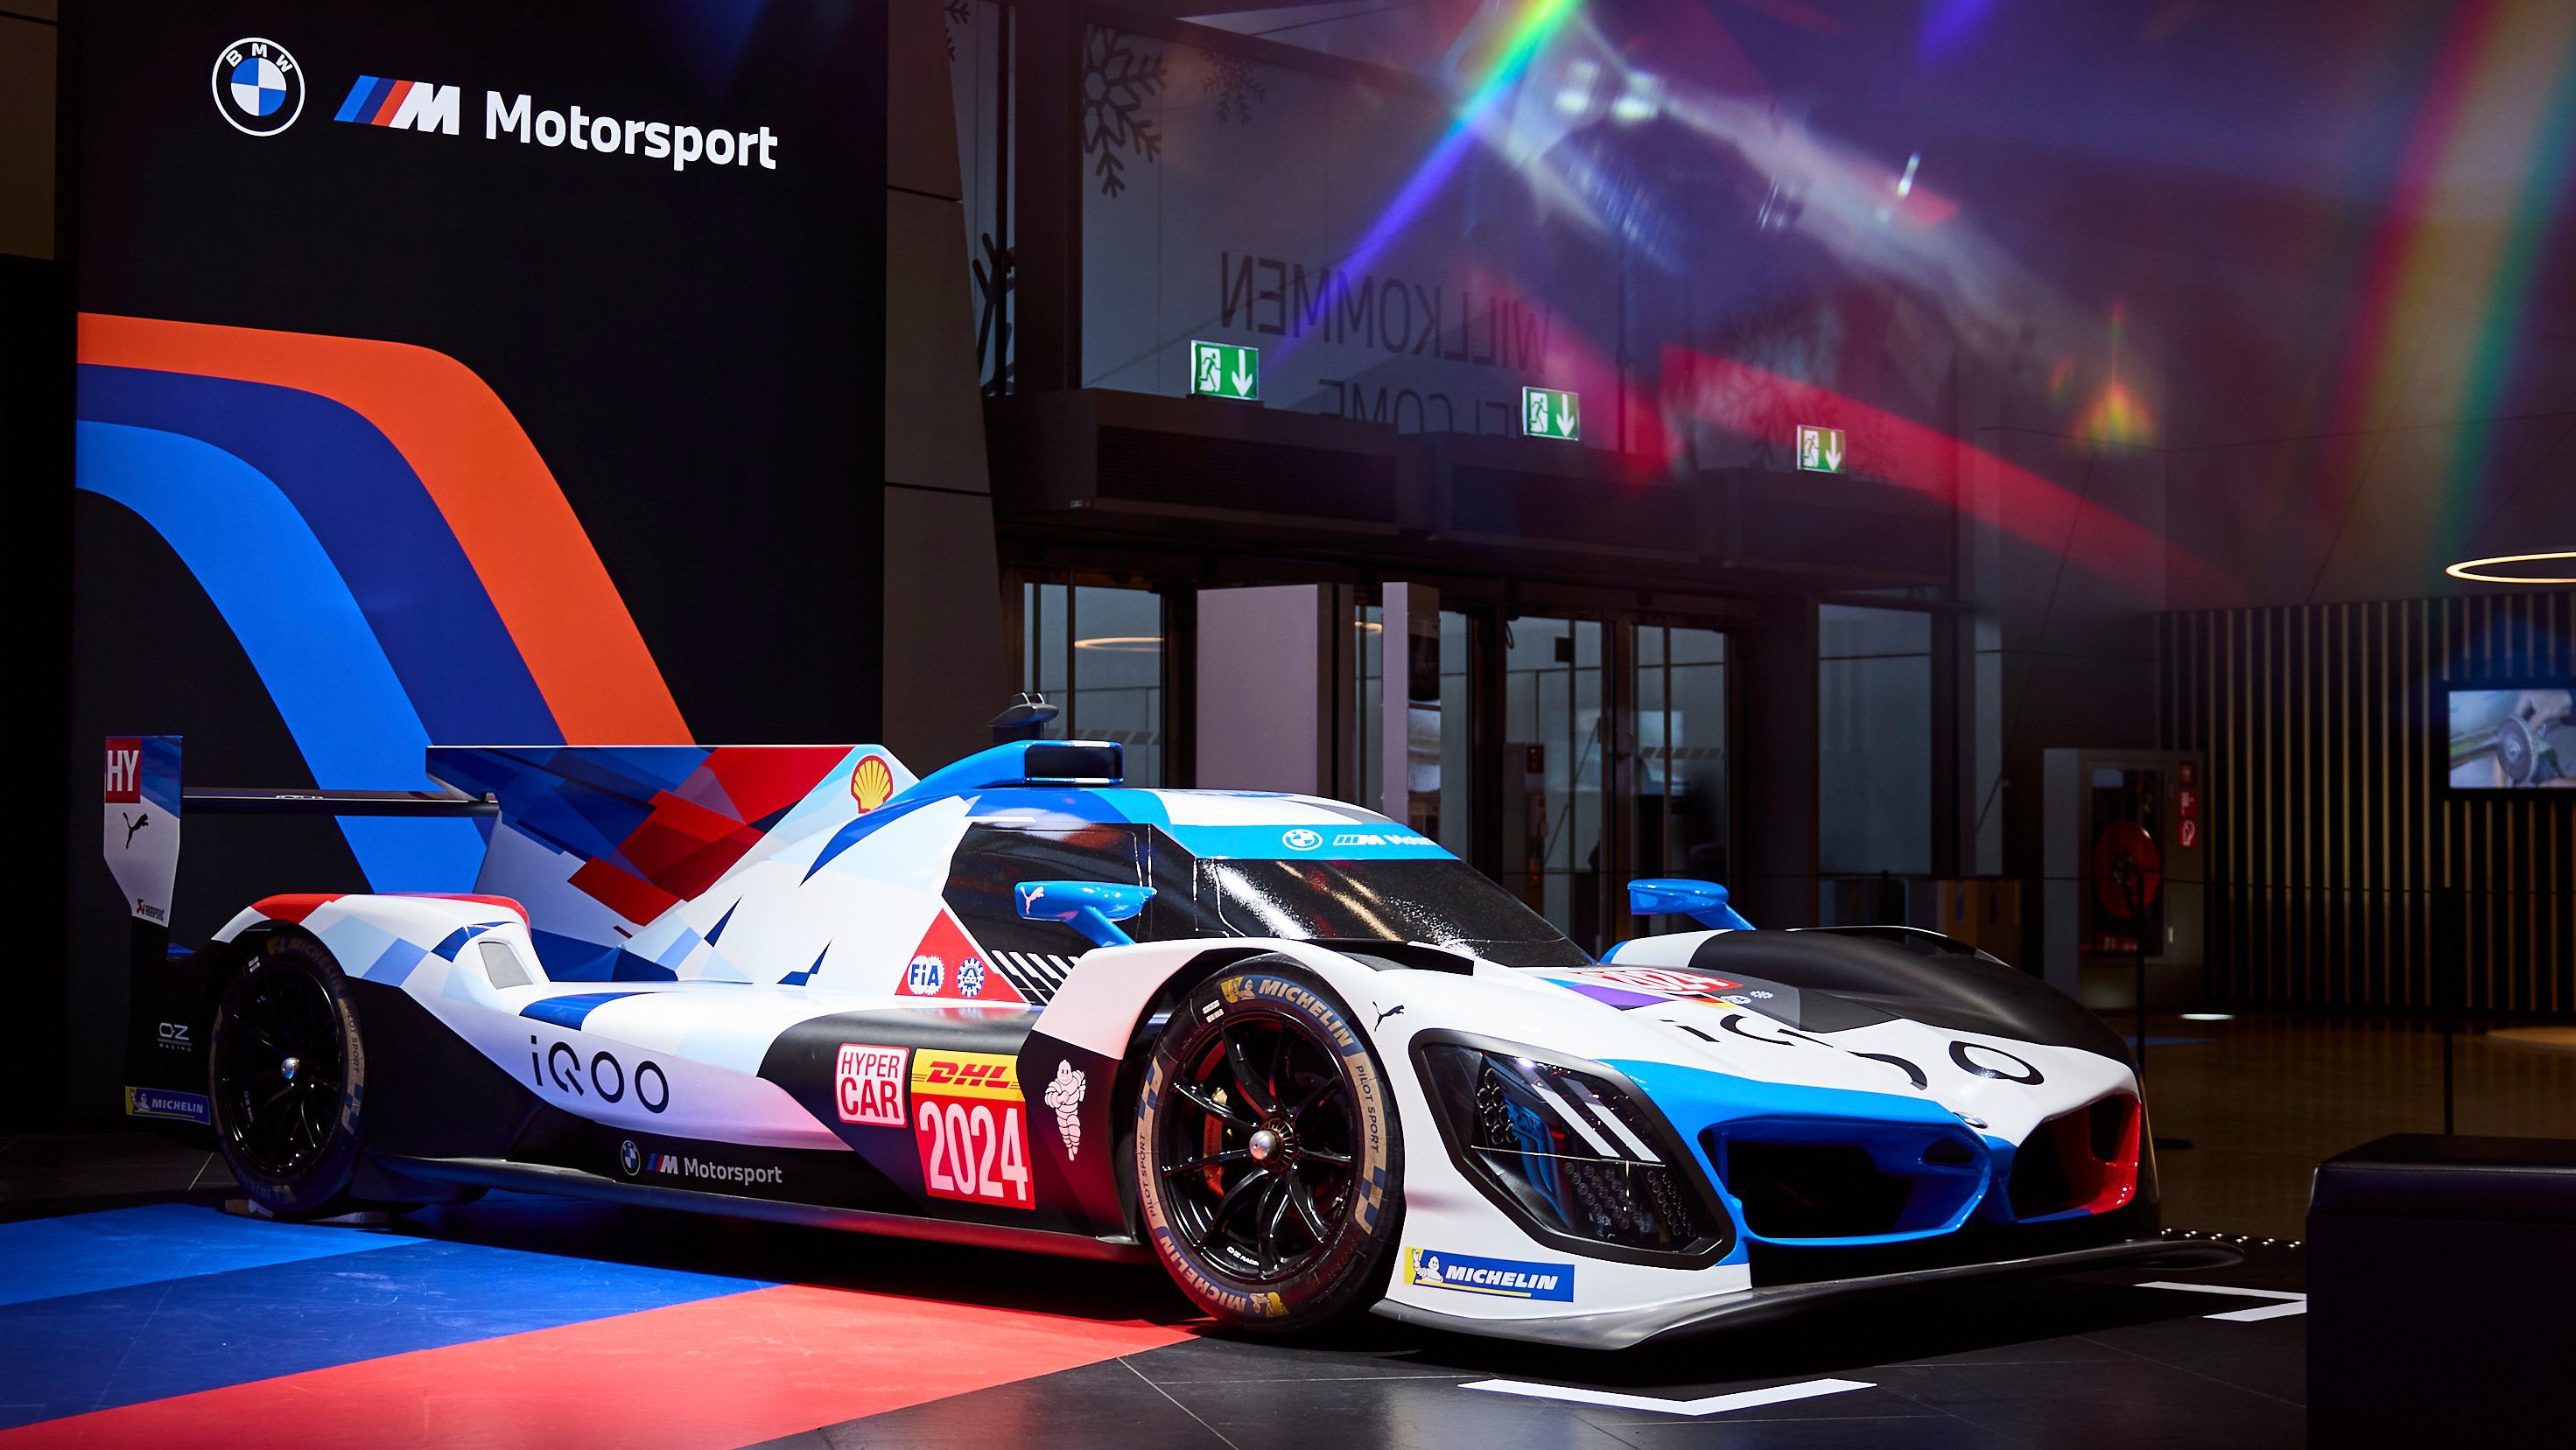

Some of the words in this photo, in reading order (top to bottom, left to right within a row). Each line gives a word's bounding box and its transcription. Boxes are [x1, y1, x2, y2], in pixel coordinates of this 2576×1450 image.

[225, 42, 293, 74] BMW
[486, 90, 778, 172] Motorsport
[106, 749, 140, 792] HY
[1259, 978, 1355, 1048] MICHELIN
[530, 1034, 670, 1114] iQOO
[840, 1051, 901, 1079] HYPER
[926, 1061, 1011, 1088] DHL
[151, 1098, 203, 1114] MICHELIN
[840, 1076, 901, 1119] CAR
[1355, 1064, 1374, 1102] PILOT
[1367, 1105, 1379, 1154] SPORT
[684, 1156, 783, 1186] Motorsport
[918, 1100, 1028, 1201] 2024
[1141, 1183, 1157, 1218] PILOT
[1159, 1236, 1247, 1313] MICHELIN
[1445, 1264, 1559, 1291] MICHELIN
